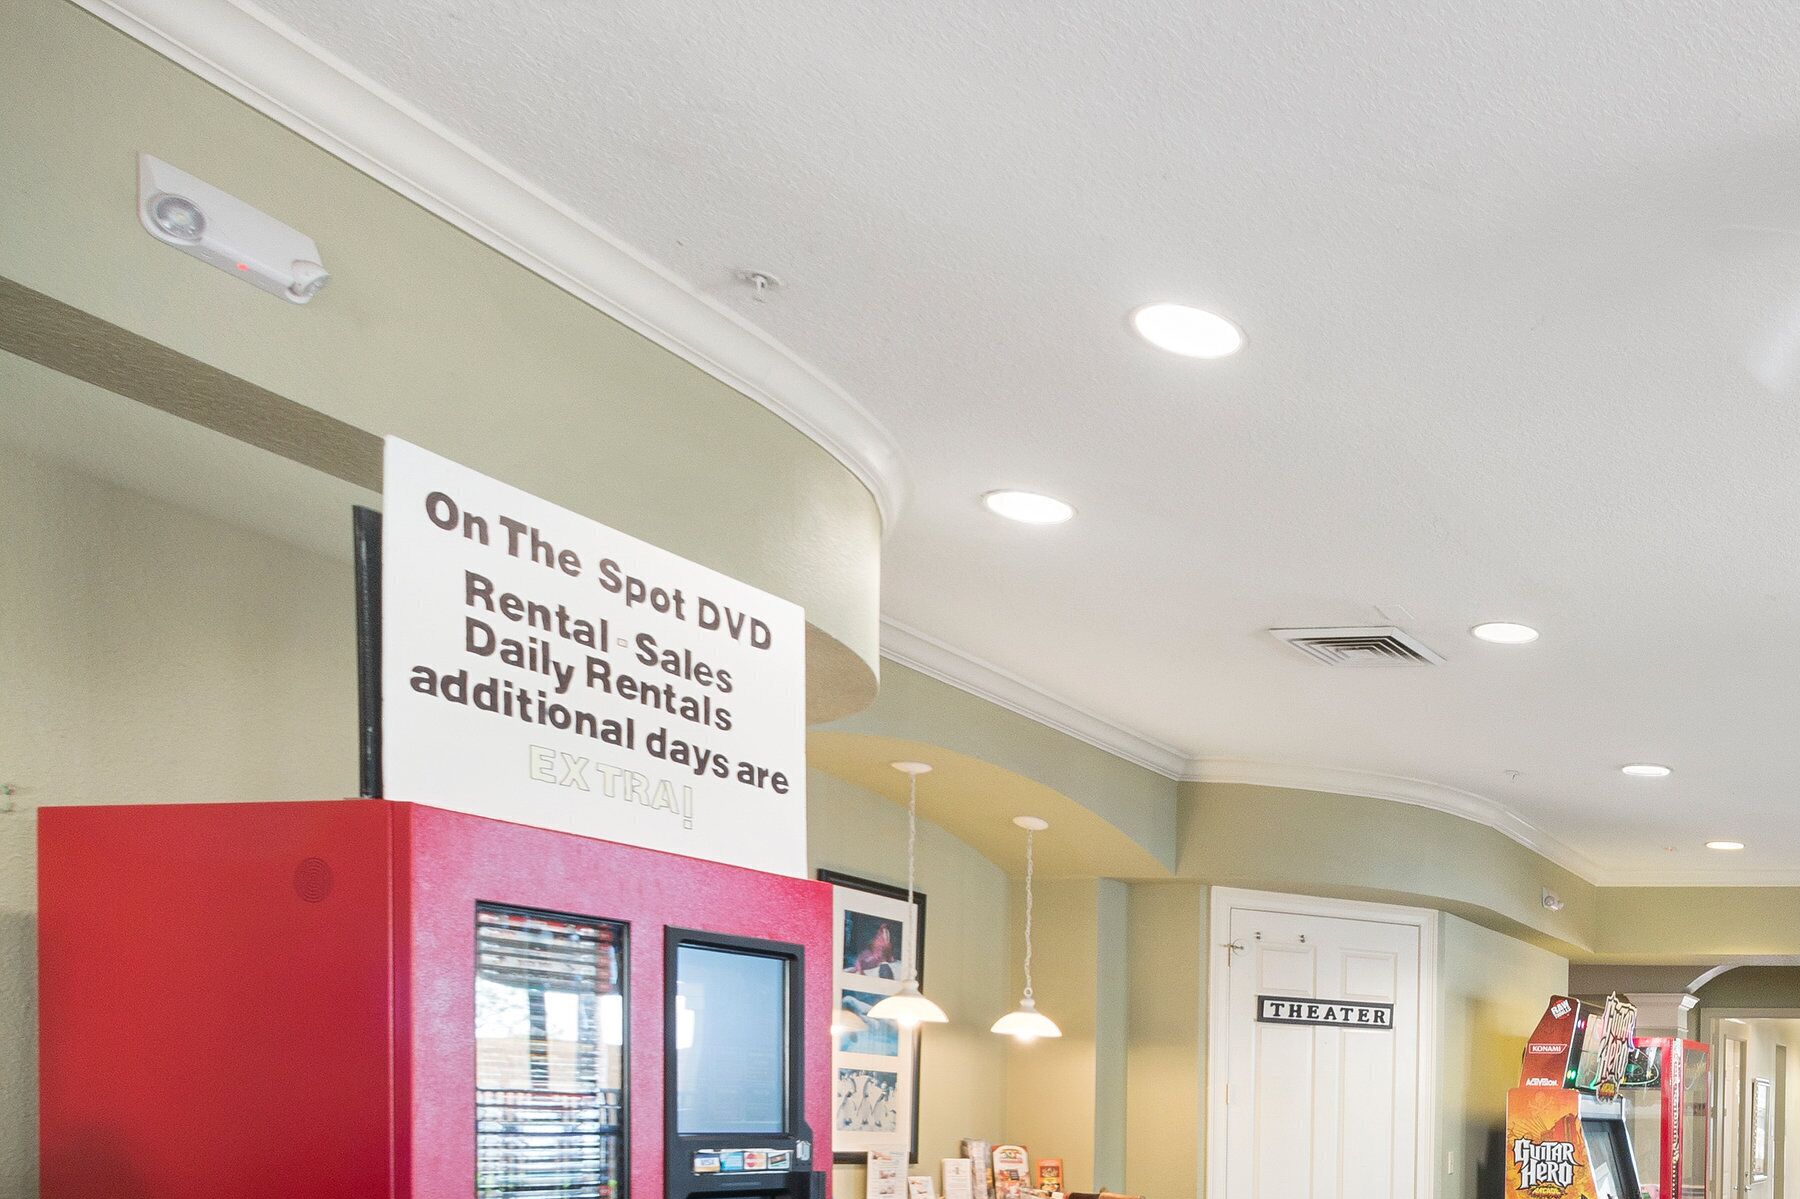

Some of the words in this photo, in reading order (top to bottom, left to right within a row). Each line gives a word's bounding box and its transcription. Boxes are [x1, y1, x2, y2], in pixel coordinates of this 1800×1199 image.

[425, 491, 489, 545] On
[499, 515, 582, 578] The
[599, 558, 686, 622] Spot
[698, 597, 771, 651] DVD
[465, 570, 609, 653] Rental
[635, 633, 733, 693] Sales
[465, 615, 575, 693] Daily
[586, 657, 732, 732] Rentals
[409, 664, 634, 750] additional
[645, 727, 730, 781] days
[737, 762, 790, 795] are
[529, 744, 694, 830] EXTRA!
[1270, 1002, 1386, 1024] THEATER
[1551, 999, 1571, 1015] RAW
